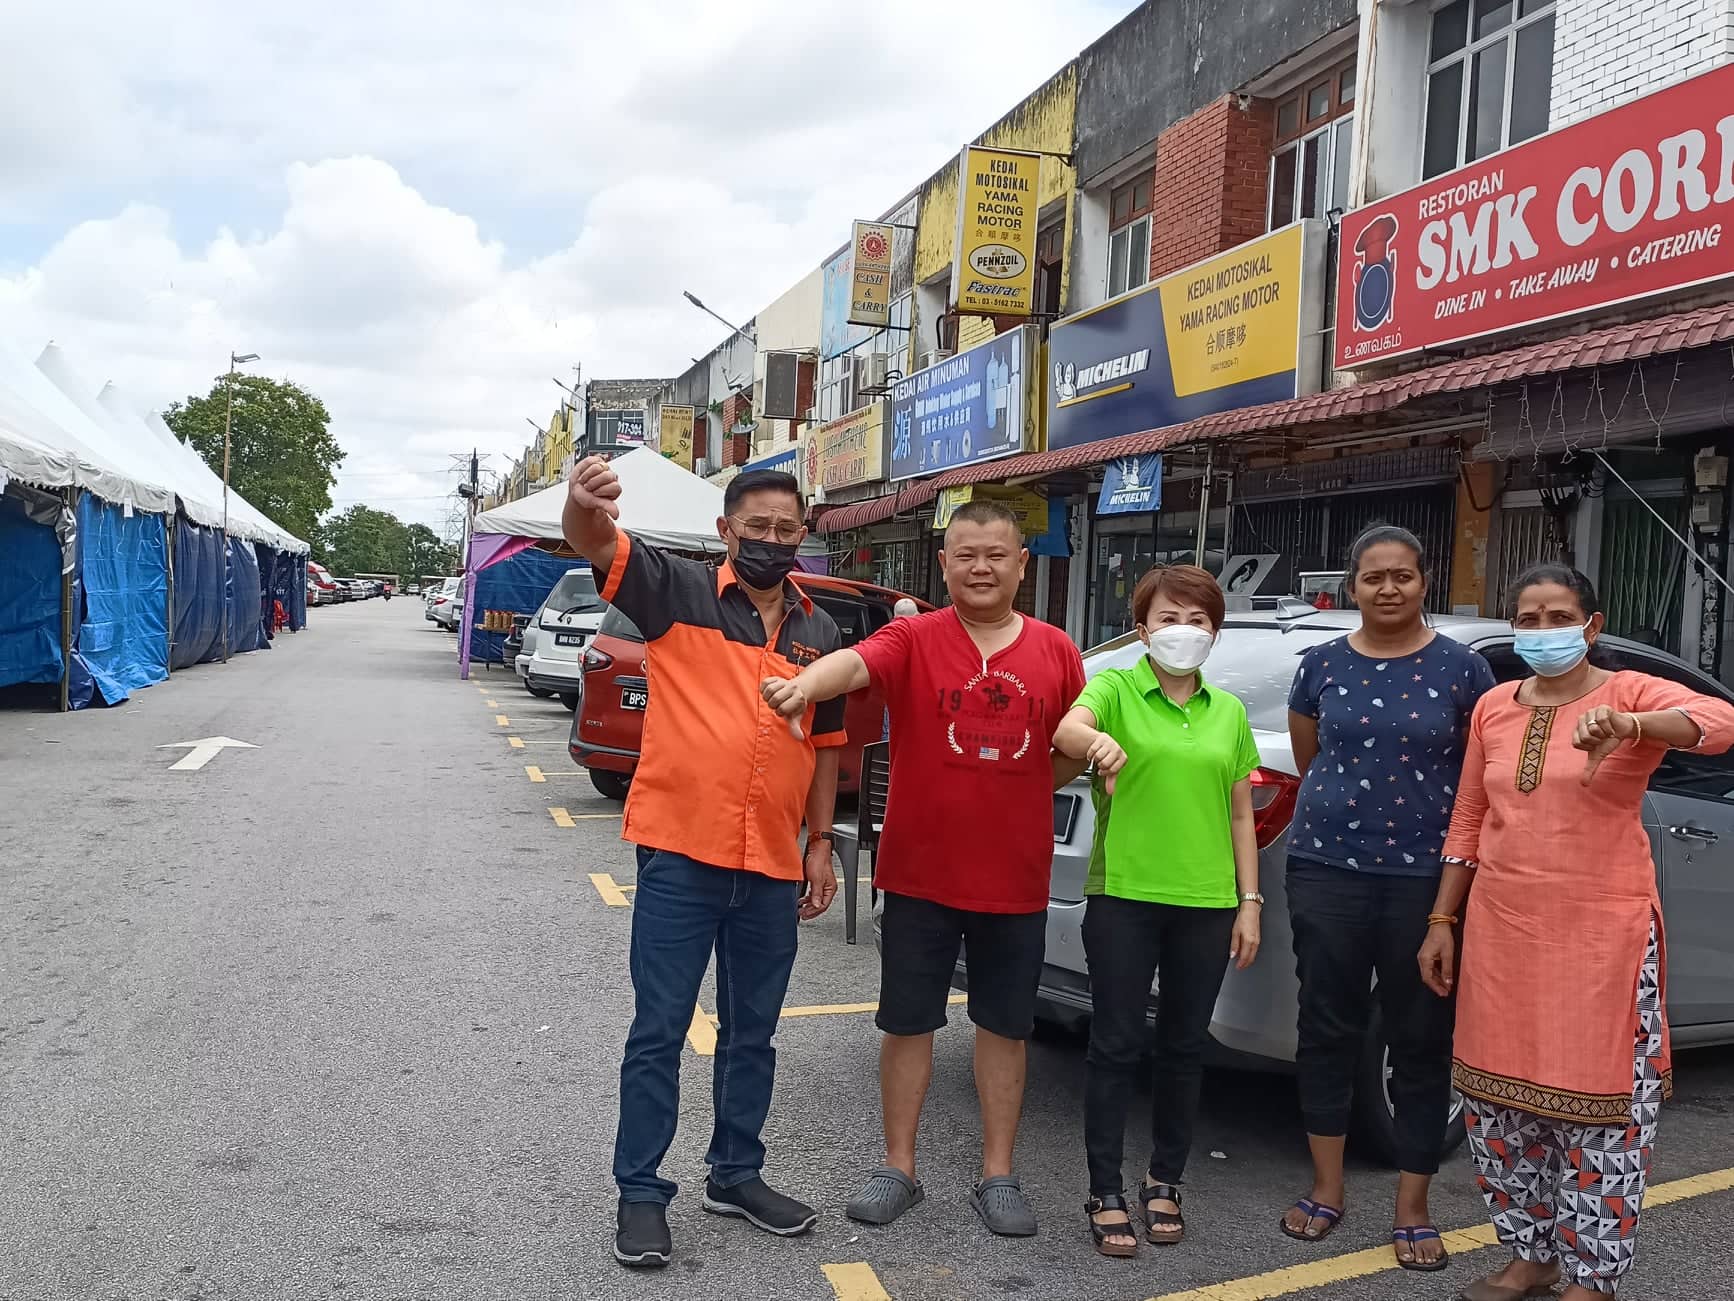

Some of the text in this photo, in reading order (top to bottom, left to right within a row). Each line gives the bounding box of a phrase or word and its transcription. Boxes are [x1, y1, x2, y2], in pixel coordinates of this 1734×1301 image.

[990, 159, 1018, 174] KEDAI
[975, 173, 1029, 192] MOTOSIKAL
[984, 190, 1018, 203] YAMA
[1418, 169, 1504, 220] RESTORAN
[977, 203, 1024, 216] RACING
[977, 214, 1022, 229] MOTOR
[1416, 186, 1539, 290] SMK
[977, 255, 1019, 267] PENNZOIL
[856, 272, 883, 285] CASH
[1187, 253, 1273, 302] KEDAI MOTOSIKAL
[1434, 223, 1722, 320] DINE IN TAKE AWAY CATERING
[864, 287, 873, 299] &
[966, 280, 1022, 297] Fastrac
[852, 301, 887, 313] CARRY
[965, 296, 977, 304] TEL
[1179, 281, 1280, 333] YAMA RACING MOTOR
[1206, 323, 1247, 355] 合顺摩哆
[1076, 349, 1151, 389] MICHELIN
[894, 382, 916, 402] KEDAI
[917, 373, 929, 396] AIR
[931, 355, 969, 389] MINUMAN
[1110, 489, 1150, 505] MICHELIN
[964, 670, 1026, 697] SANTA BARBARA
[629, 692, 646, 706] BPS
[938, 687, 962, 711] 19
